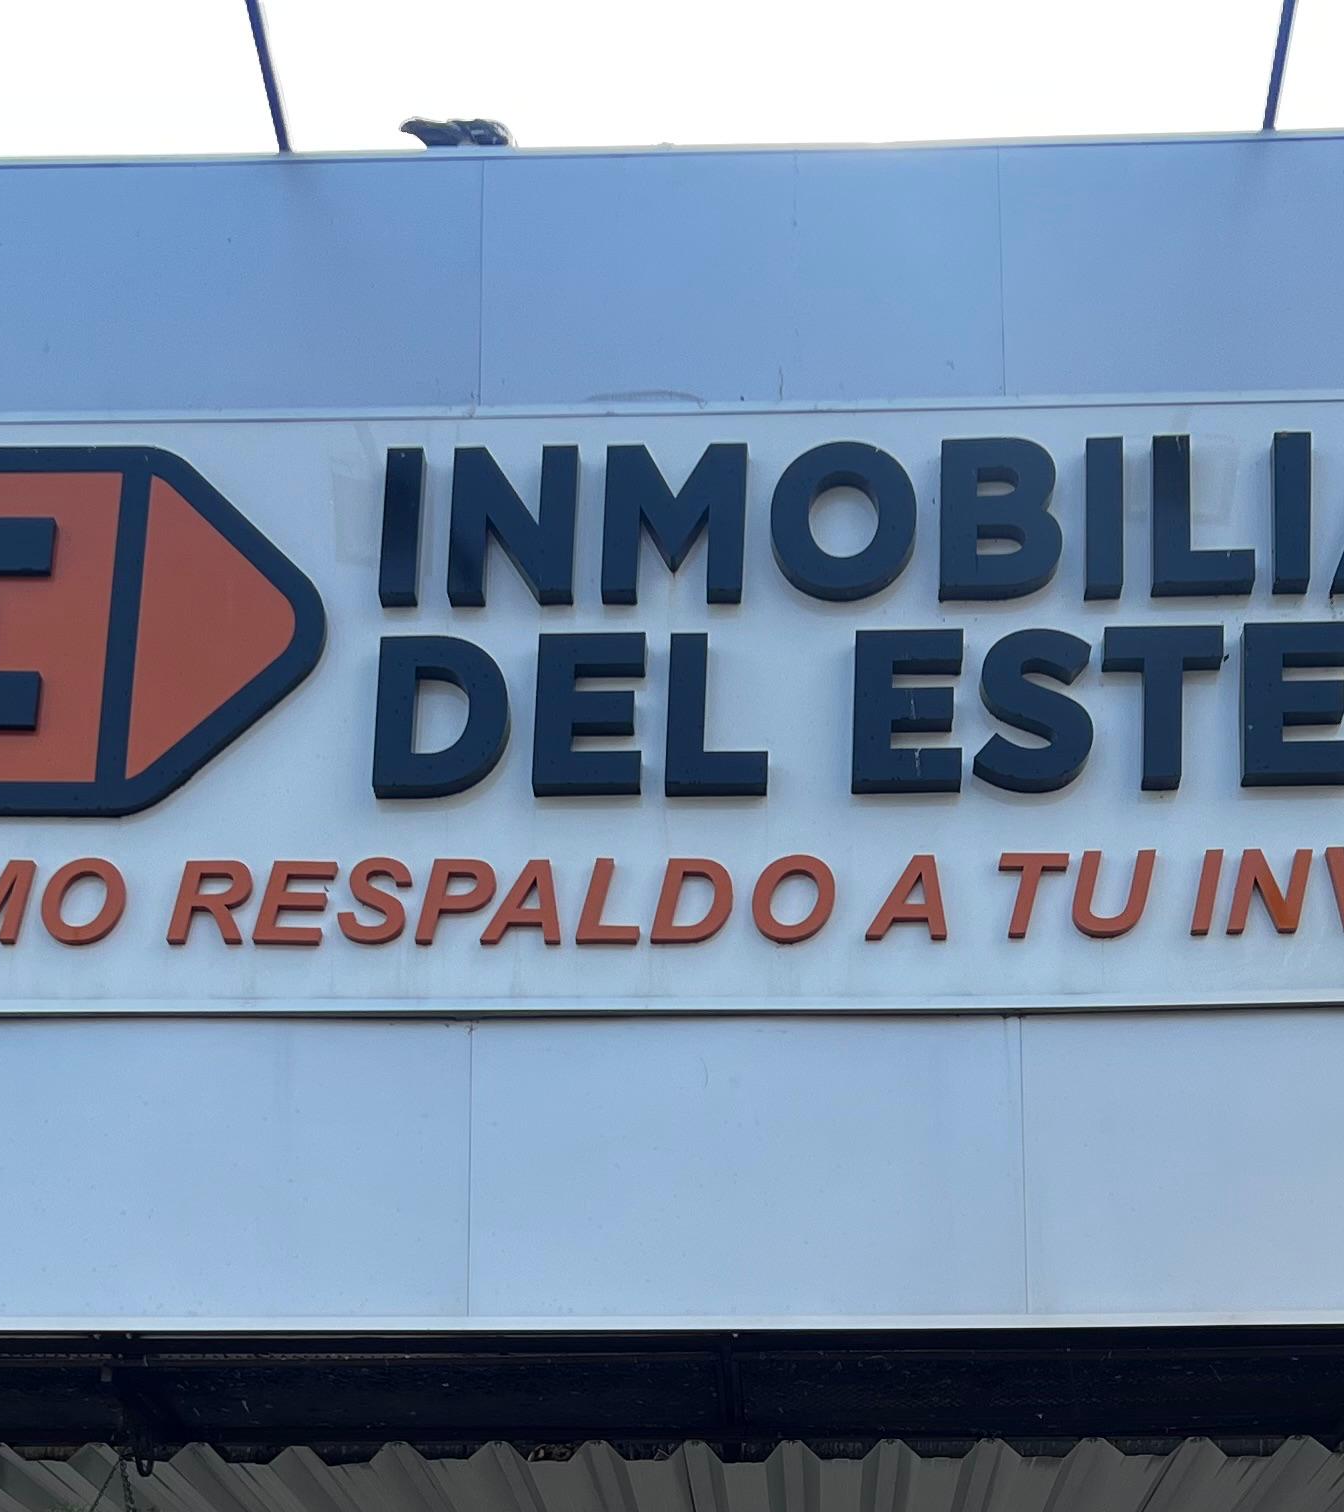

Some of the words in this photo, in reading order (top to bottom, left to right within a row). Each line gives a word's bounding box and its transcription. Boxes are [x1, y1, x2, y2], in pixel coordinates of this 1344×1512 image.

[372, 632, 768, 800] DEL
[167, 854, 835, 946] RESPALDO
[864, 853, 948, 942] A
[996, 849, 1157, 940] TU
